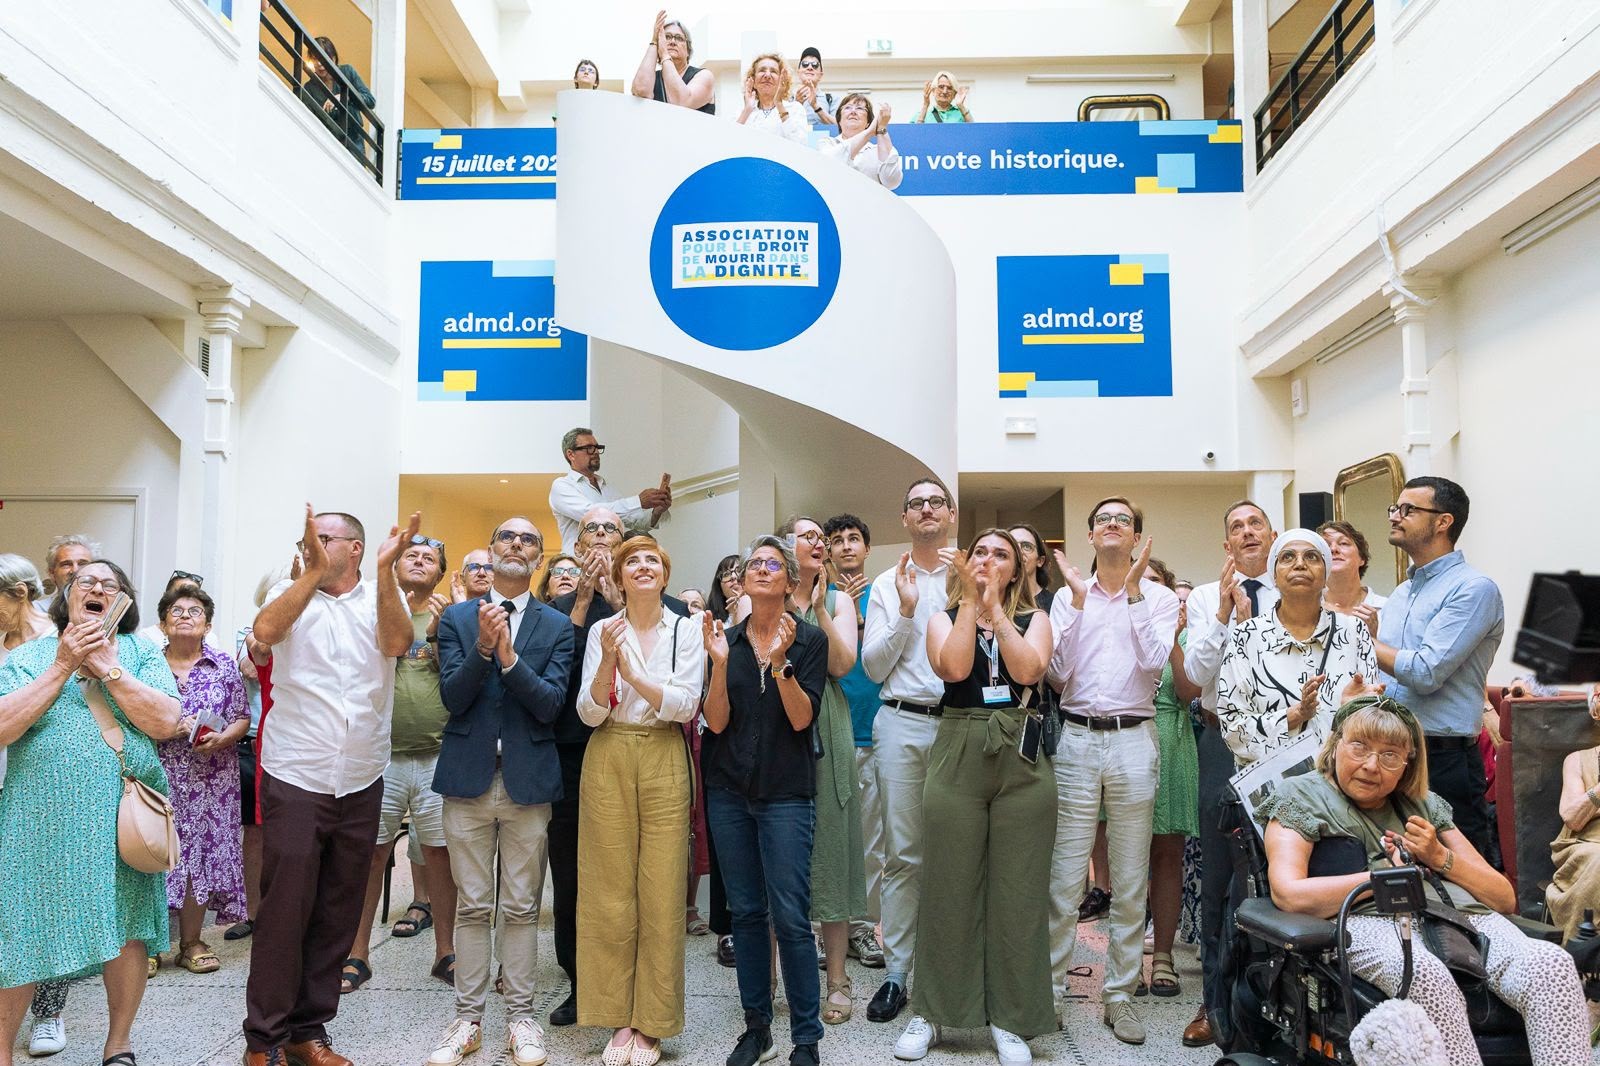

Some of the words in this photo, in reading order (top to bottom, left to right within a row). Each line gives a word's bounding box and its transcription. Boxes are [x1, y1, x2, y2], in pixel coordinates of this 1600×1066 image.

[421, 155, 445, 173] 15
[445, 153, 516, 177] juillet
[898, 155, 919, 170] n
[926, 151, 982, 170] vote
[990, 149, 1125, 174] historique.
[682, 229, 809, 243] ASSOCIATION
[682, 242, 726, 254] POUR
[733, 242, 751, 253] LE
[758, 241, 809, 252] DROIT
[682, 255, 700, 265] DE
[705, 254, 765, 264] MOURIR
[769, 253, 809, 263] DANS
[682, 266, 707, 279] LA
[443, 312, 561, 337] admd.org
[1022, 307, 1143, 332] admd.org
